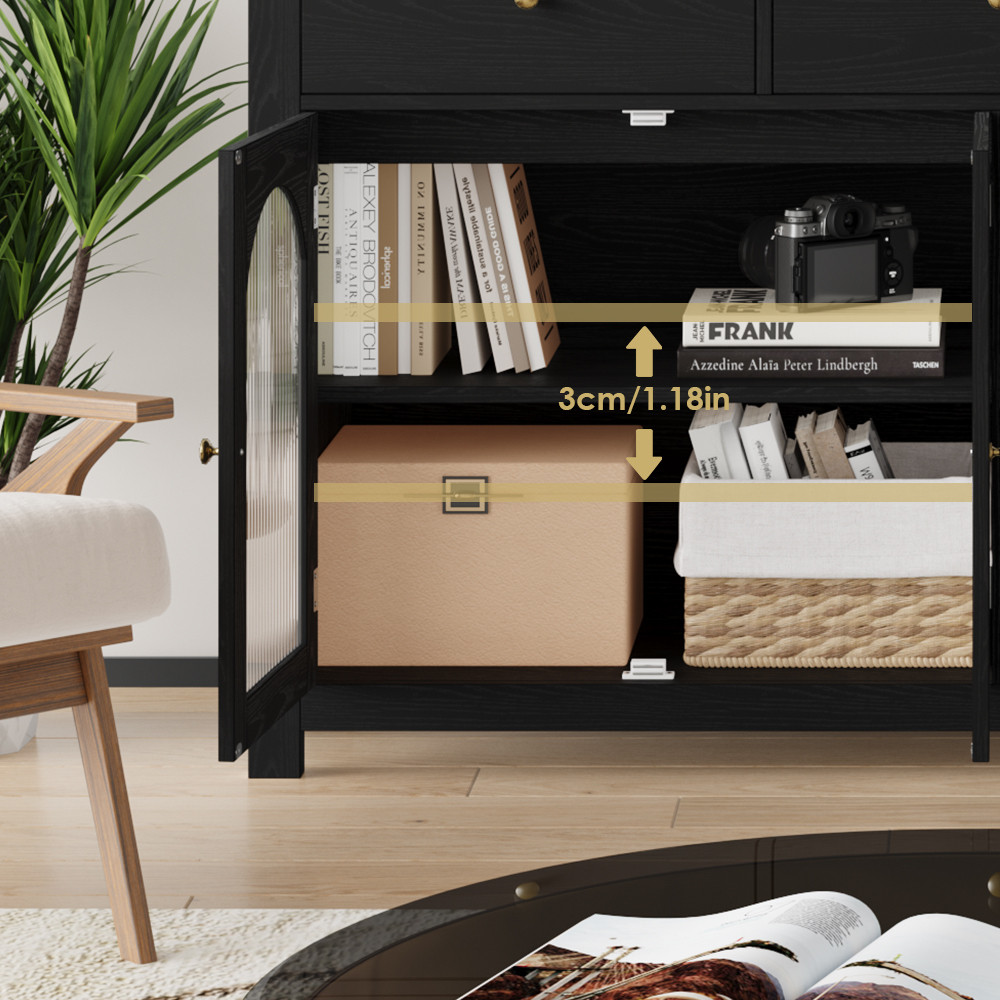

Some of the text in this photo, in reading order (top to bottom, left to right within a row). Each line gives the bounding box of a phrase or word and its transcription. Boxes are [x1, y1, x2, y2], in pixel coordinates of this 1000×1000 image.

[318, 164, 329, 255] OST FISH
[363, 163, 376, 233] ALEXEY
[347, 208, 358, 318] ANTIQUAIRES
[363, 239, 376, 361] BRODOVITCH
[708, 322, 794, 340] FRANK
[690, 358, 878, 374] Azzedine Alaïa Peter Lindbergh
[912, 361, 940, 369] TASCHEN
